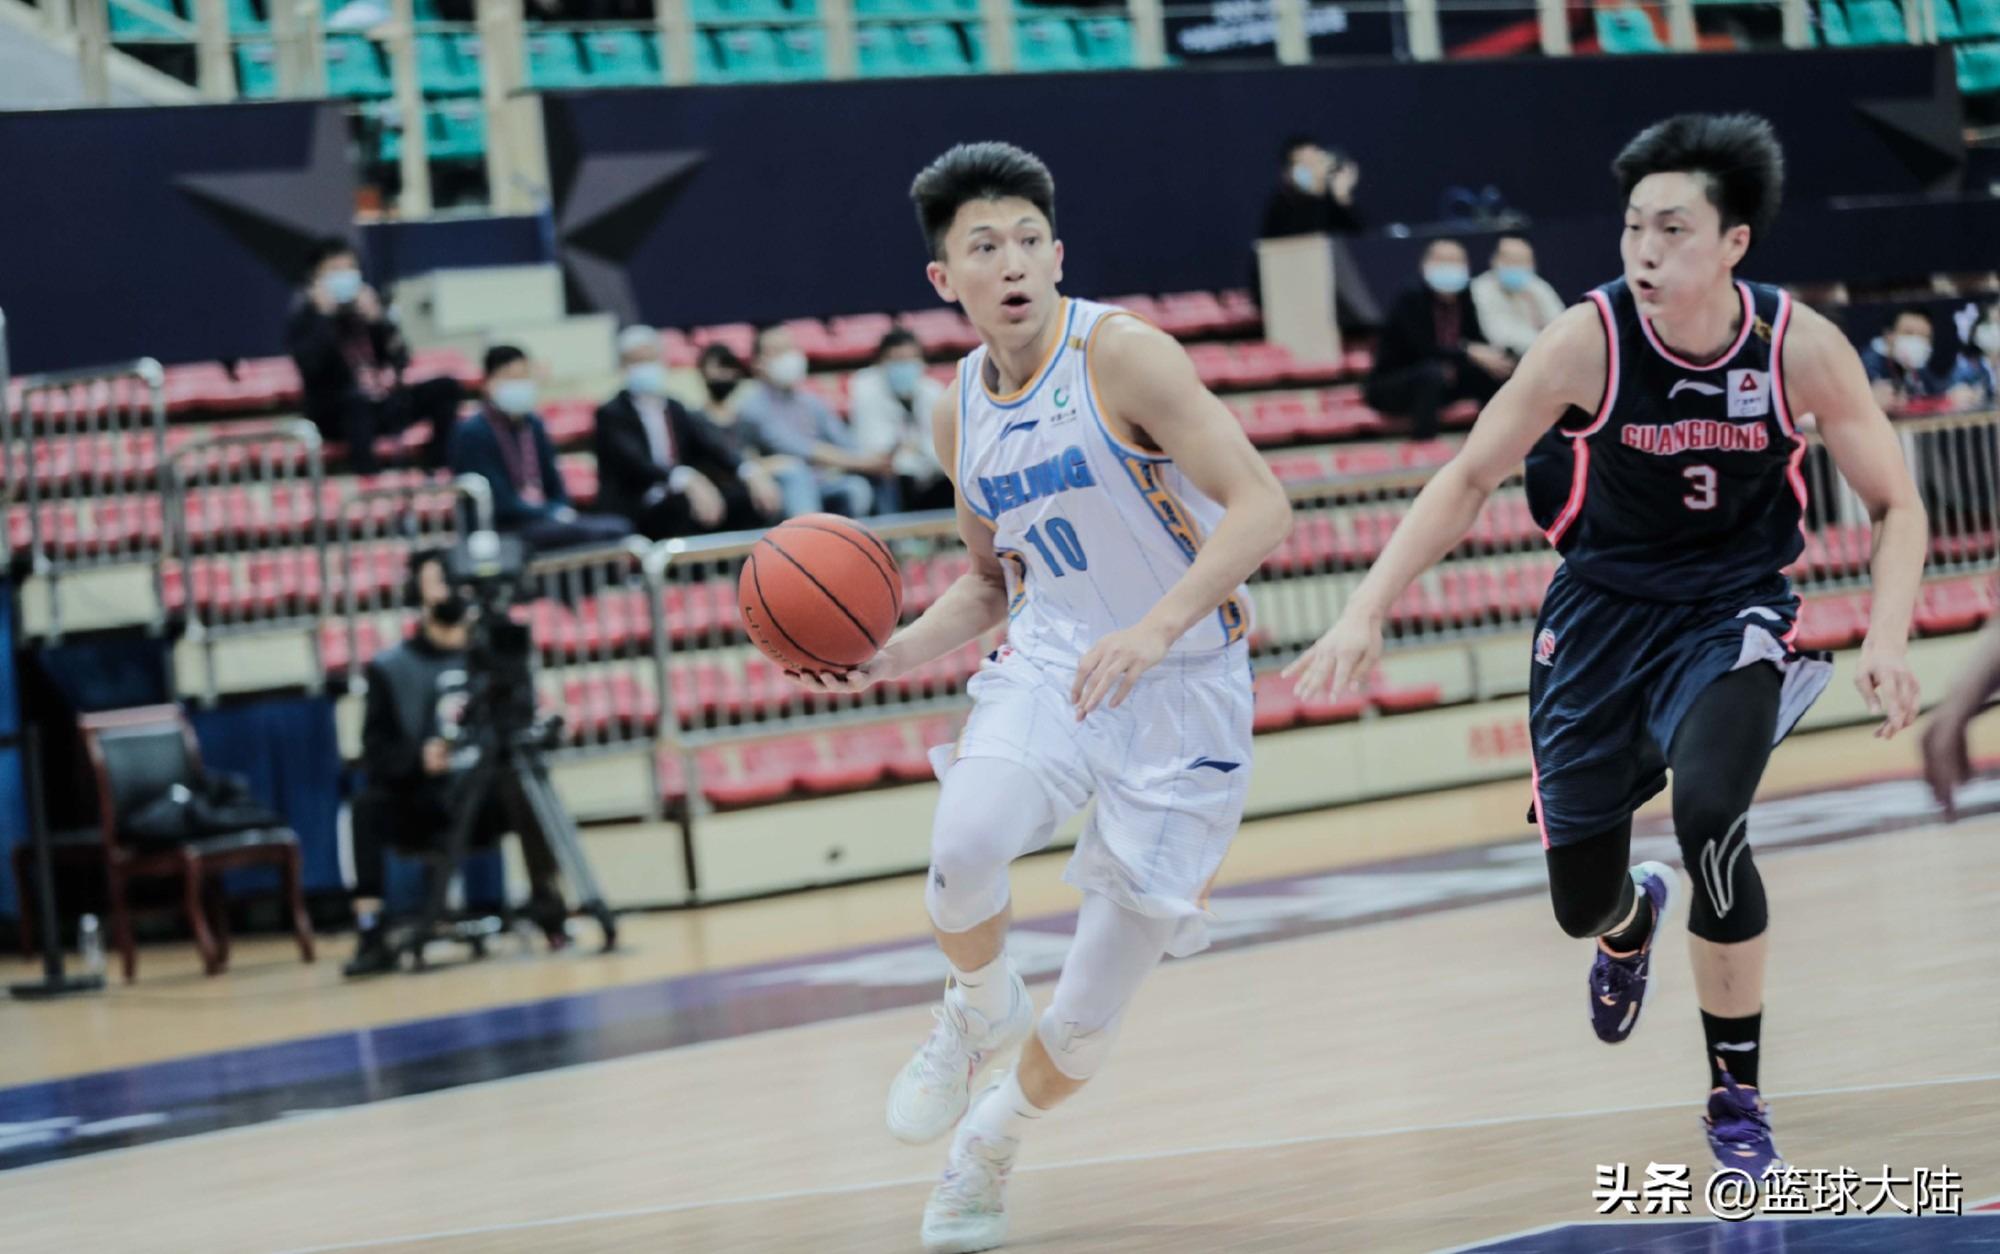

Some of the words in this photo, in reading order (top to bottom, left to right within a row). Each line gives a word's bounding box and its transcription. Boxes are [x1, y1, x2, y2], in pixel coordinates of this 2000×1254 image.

[1621, 419, 1769, 456] GUANGDONG
[1682, 464, 1718, 510] 3
[1024, 516, 1088, 577] 10
